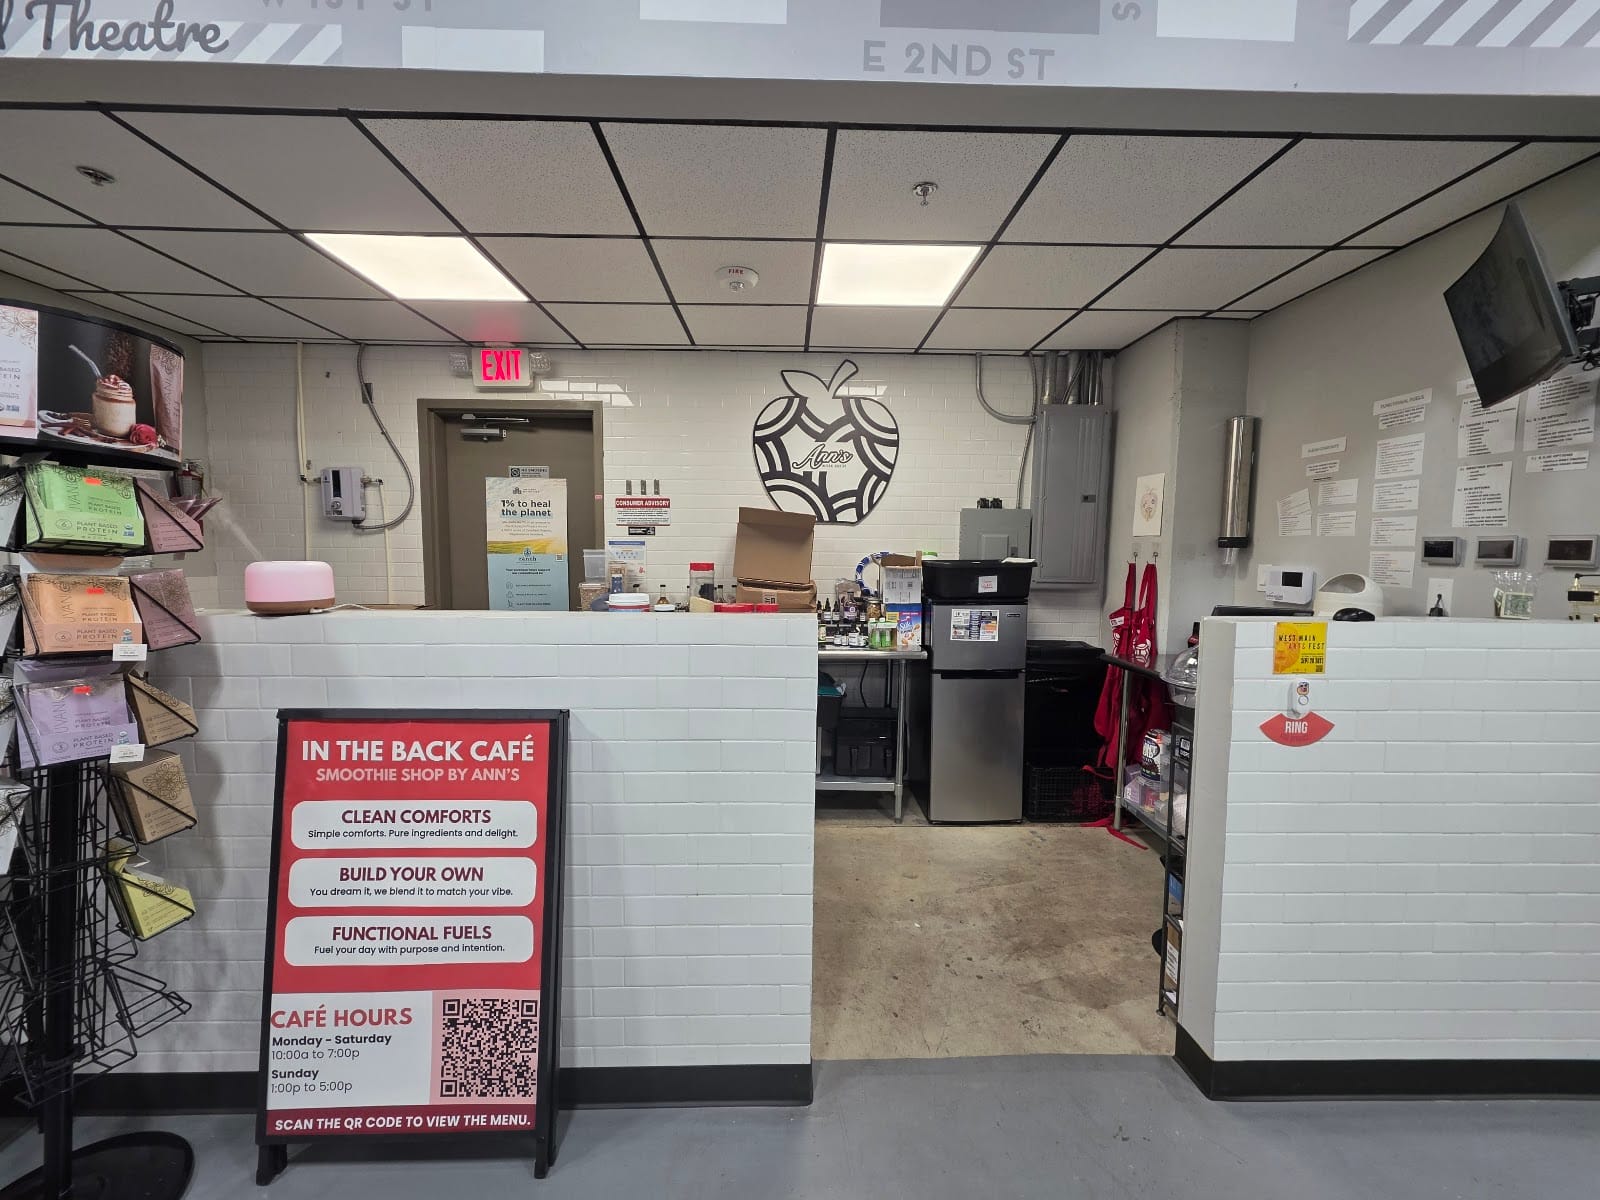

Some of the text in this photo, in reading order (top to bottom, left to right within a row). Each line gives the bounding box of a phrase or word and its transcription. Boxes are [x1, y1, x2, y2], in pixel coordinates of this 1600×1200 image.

[25, 0, 229, 53] Theatre
[863, 40, 1055, 80] E 2ND ST
[481, 349, 522, 382] EXIT
[792, 443, 853, 469] Ann's
[501, 499, 551, 508] 1% to heal
[501, 508, 551, 518] the planet
[76, 527, 118, 535] PROTEIN
[1278, 634, 1296, 642] WEST
[1308, 642, 1325, 650] FEST
[1284, 720, 1309, 734] RING
[73, 738, 114, 748] PROTEIN
[302, 734, 534, 761] IN THE BACK CAFÉ
[316, 768, 520, 781] SMOOTHIE SHOP BY ANN'S
[342, 809, 491, 824] CLEAN COMFORTS
[308, 828, 518, 839] Simple comforts. Pure ingredients and delight.
[339, 867, 484, 882] BUILD YOUR OWN
[310, 887, 513, 898] You dream it, we blend it to match your vibe.
[332, 926, 492, 941] FUNCTIONAL FUELS
[314, 944, 505, 956] Fuel your day with purpose and intention.
[270, 1005, 412, 1028] CAFÉ HOURS
[272, 1036, 323, 1048] Monday
[335, 1034, 392, 1047] Saturday
[272, 1048, 360, 1061] 10:00a to 7:00p
[272, 1068, 319, 1081] Sunday
[271, 1082, 352, 1095] 1:00p to 5:00p
[275, 1114, 531, 1130] SCAN THE QR CODE TO VIEW THE MENU.
